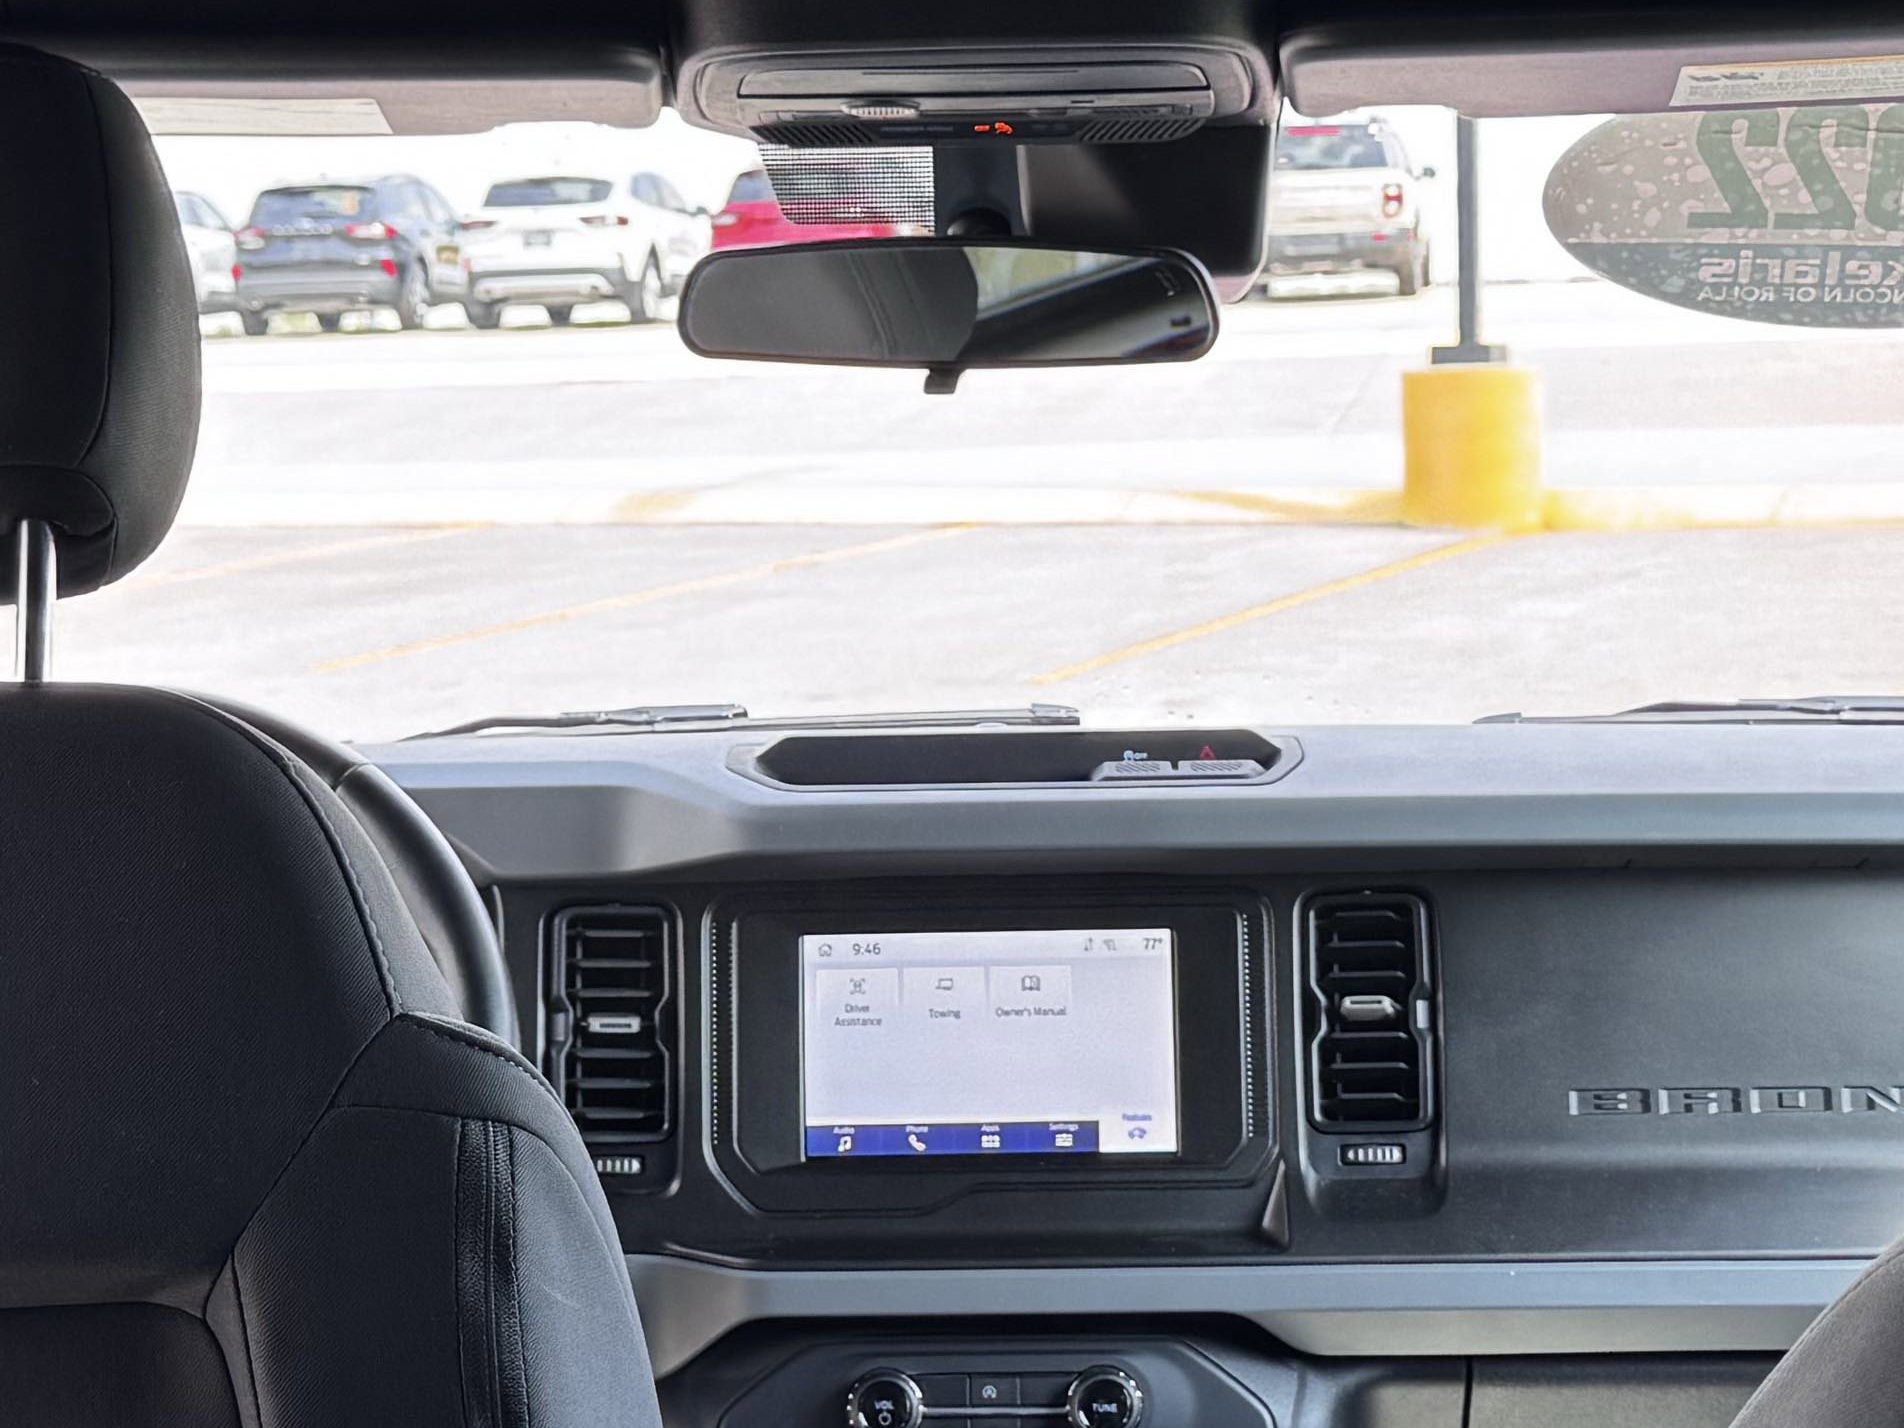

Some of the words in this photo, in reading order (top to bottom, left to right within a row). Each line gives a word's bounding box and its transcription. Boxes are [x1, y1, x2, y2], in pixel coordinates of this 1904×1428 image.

[852, 943, 881, 956] 9:46
[844, 1004, 870, 1014] Driver
[928, 1008, 961, 1020] Towing
[1033, 1005, 1066, 1016] Manual
[834, 1016, 883, 1027] Assistance
[874, 1400, 895, 1410] VOL
[1091, 1402, 1118, 1414] TUNE
